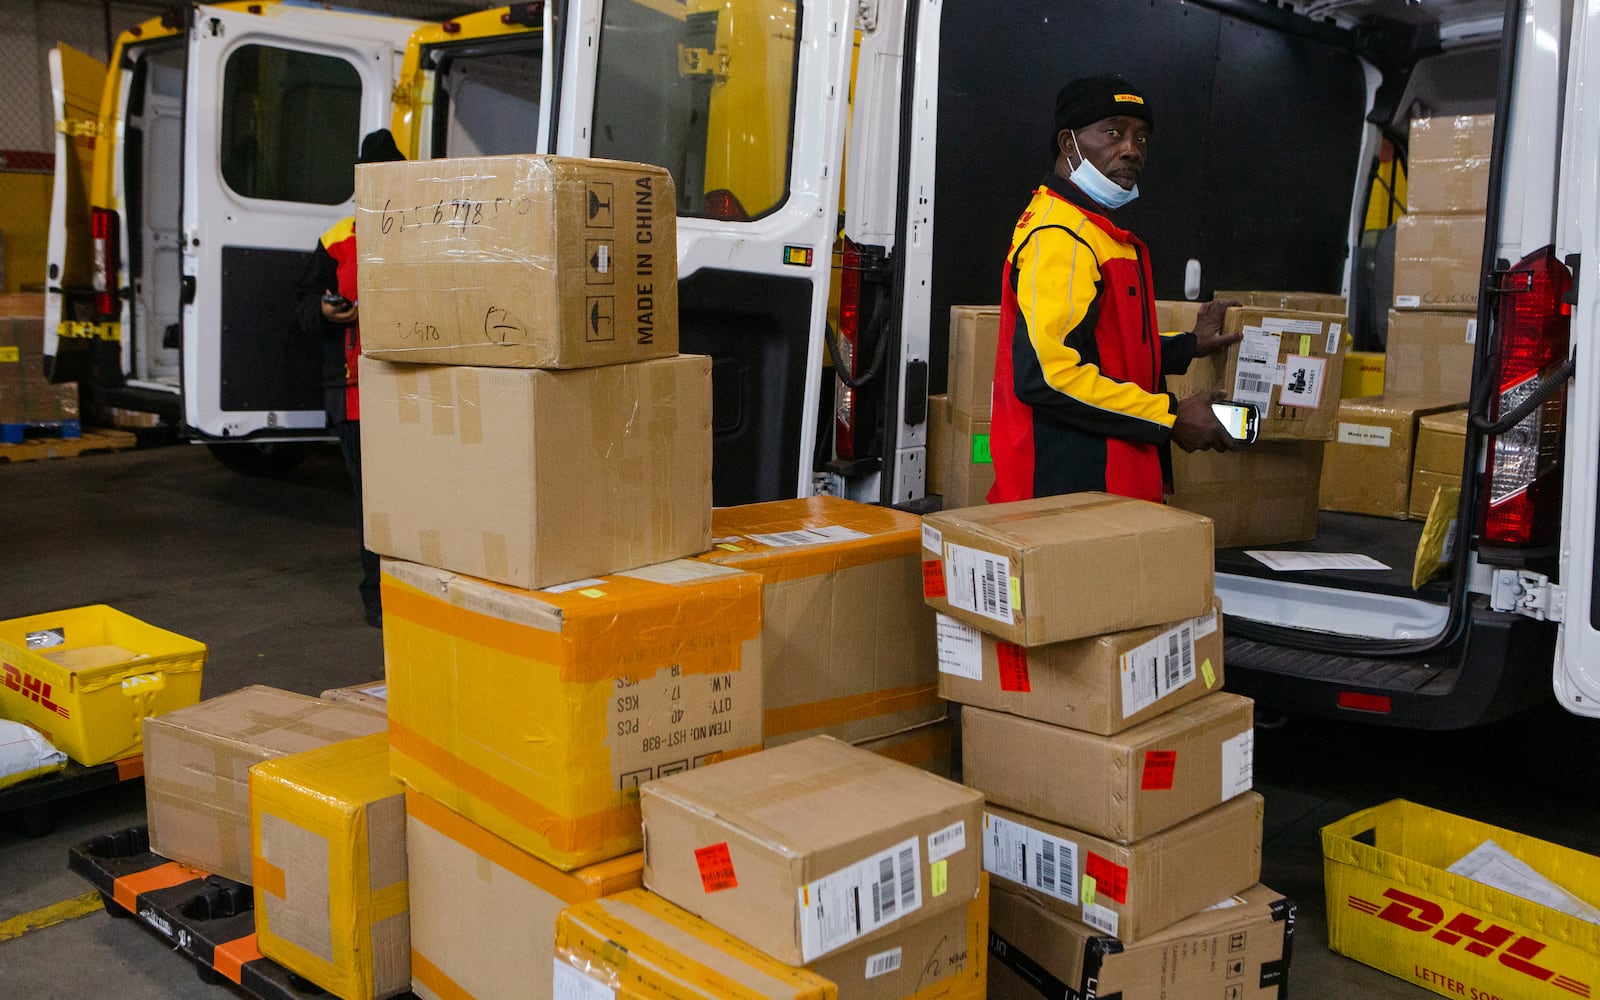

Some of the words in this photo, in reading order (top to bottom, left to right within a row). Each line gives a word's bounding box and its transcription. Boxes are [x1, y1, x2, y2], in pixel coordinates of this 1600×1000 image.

[636, 176, 653, 244] CHINA
[637, 254, 653, 275] IN
[637, 283, 653, 345] MADE
[2, 662, 58, 713] DHL
[617, 695, 639, 713] KGS
[617, 718, 639, 736] PCS
[671, 710, 684, 724] 40
[709, 719, 732, 734] ITEM
[642, 731, 687, 752] HST-838
[690, 726, 707, 740] NO:
[1377, 887, 1555, 981] DHL
[1415, 964, 1465, 996] LETTER
